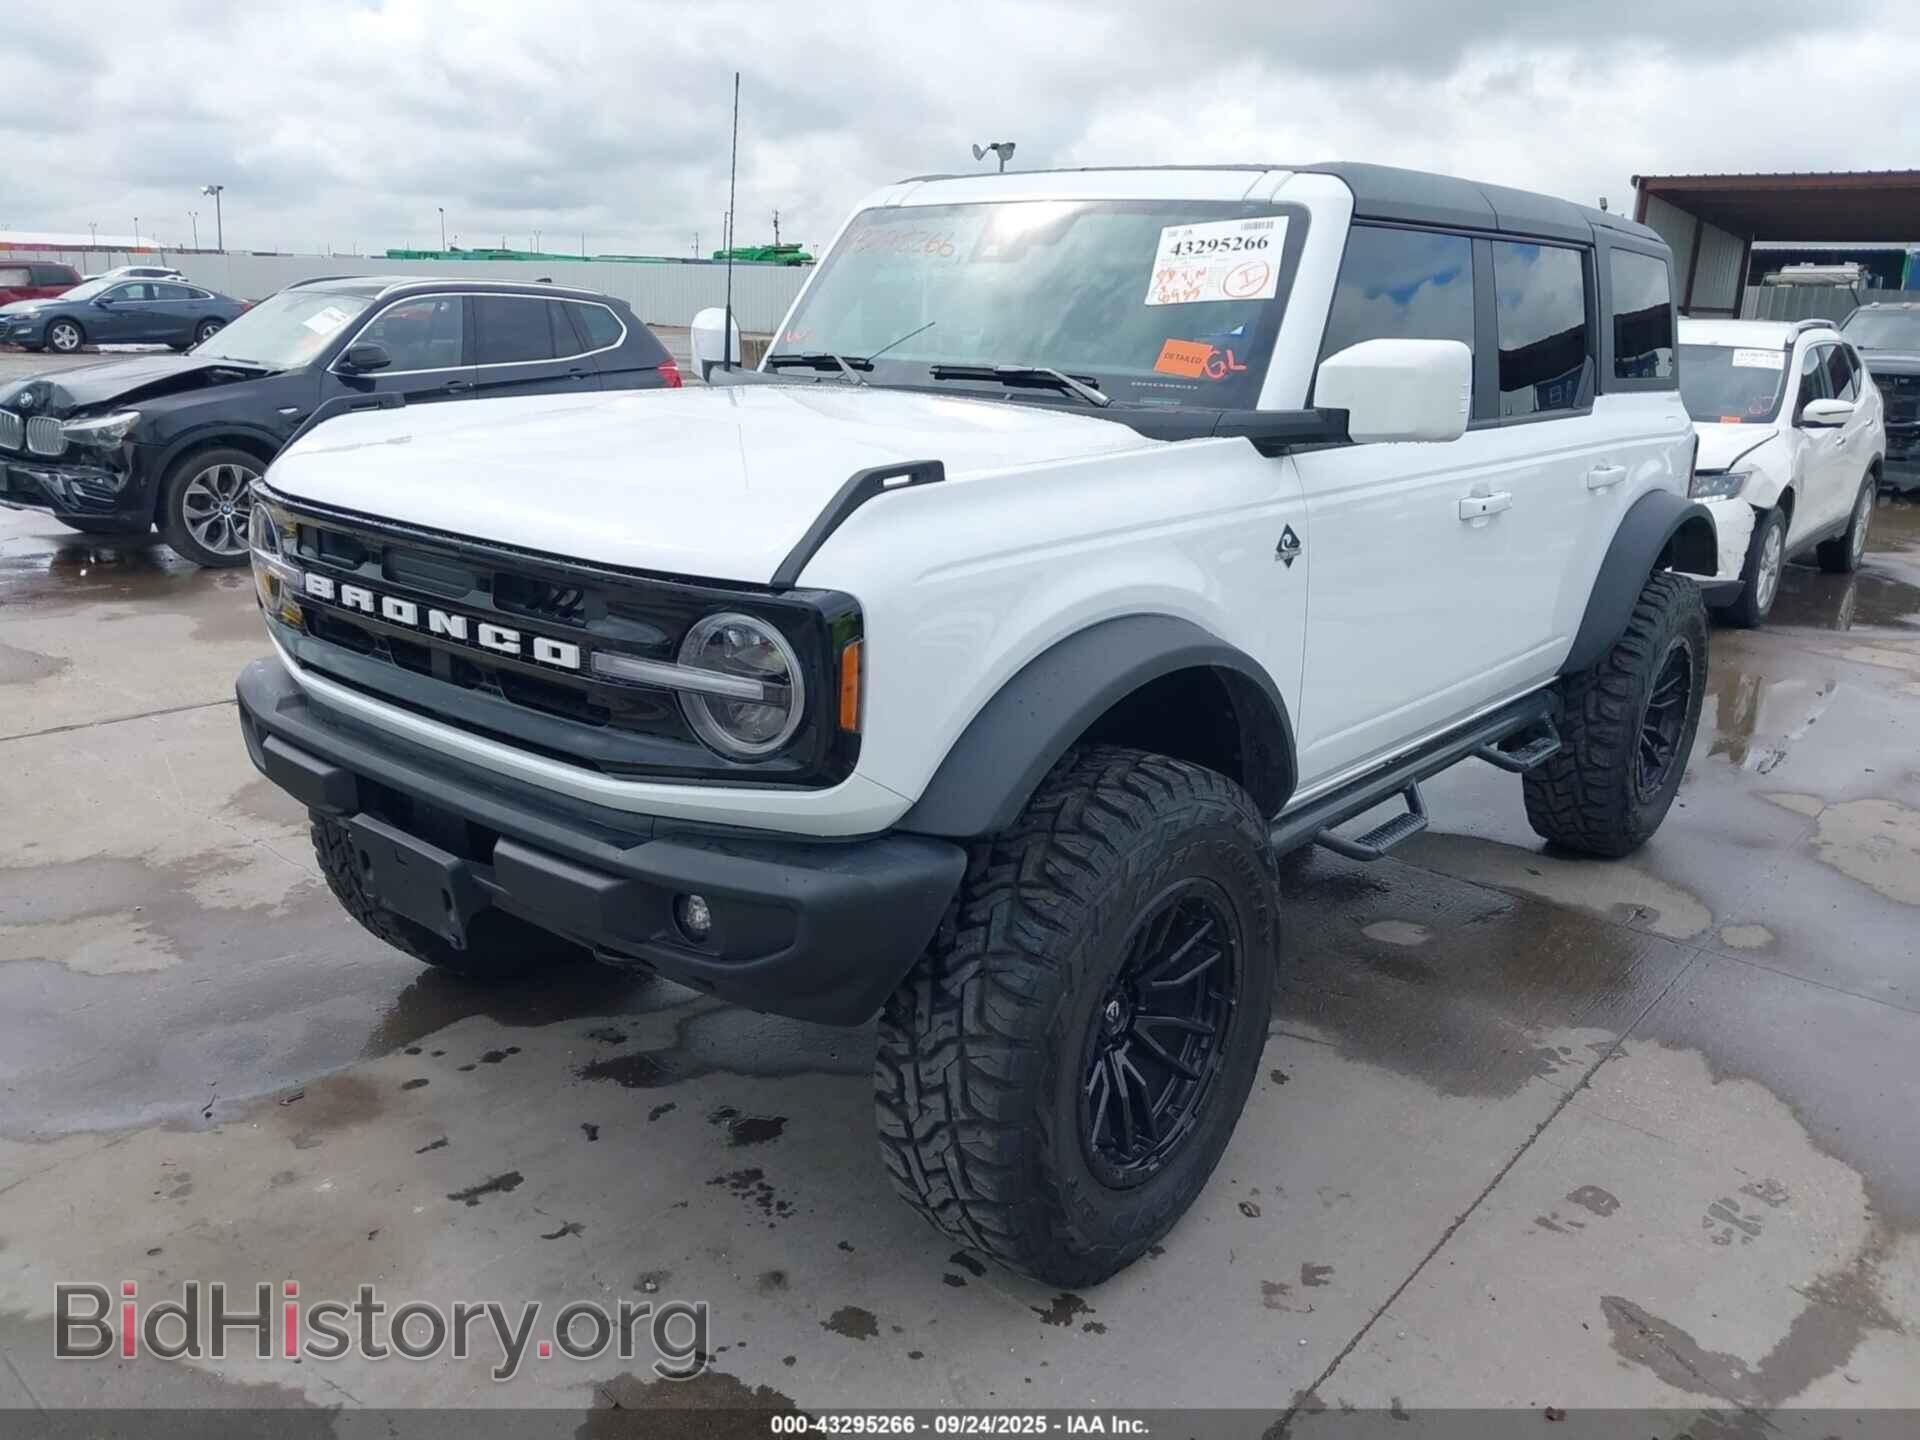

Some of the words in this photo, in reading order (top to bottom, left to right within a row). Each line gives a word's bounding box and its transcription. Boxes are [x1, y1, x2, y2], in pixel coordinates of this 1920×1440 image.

[1170, 235, 1269, 256] 43295266
[1164, 352, 1201, 365] DETAILED
[304, 572, 581, 670] BRONCO
